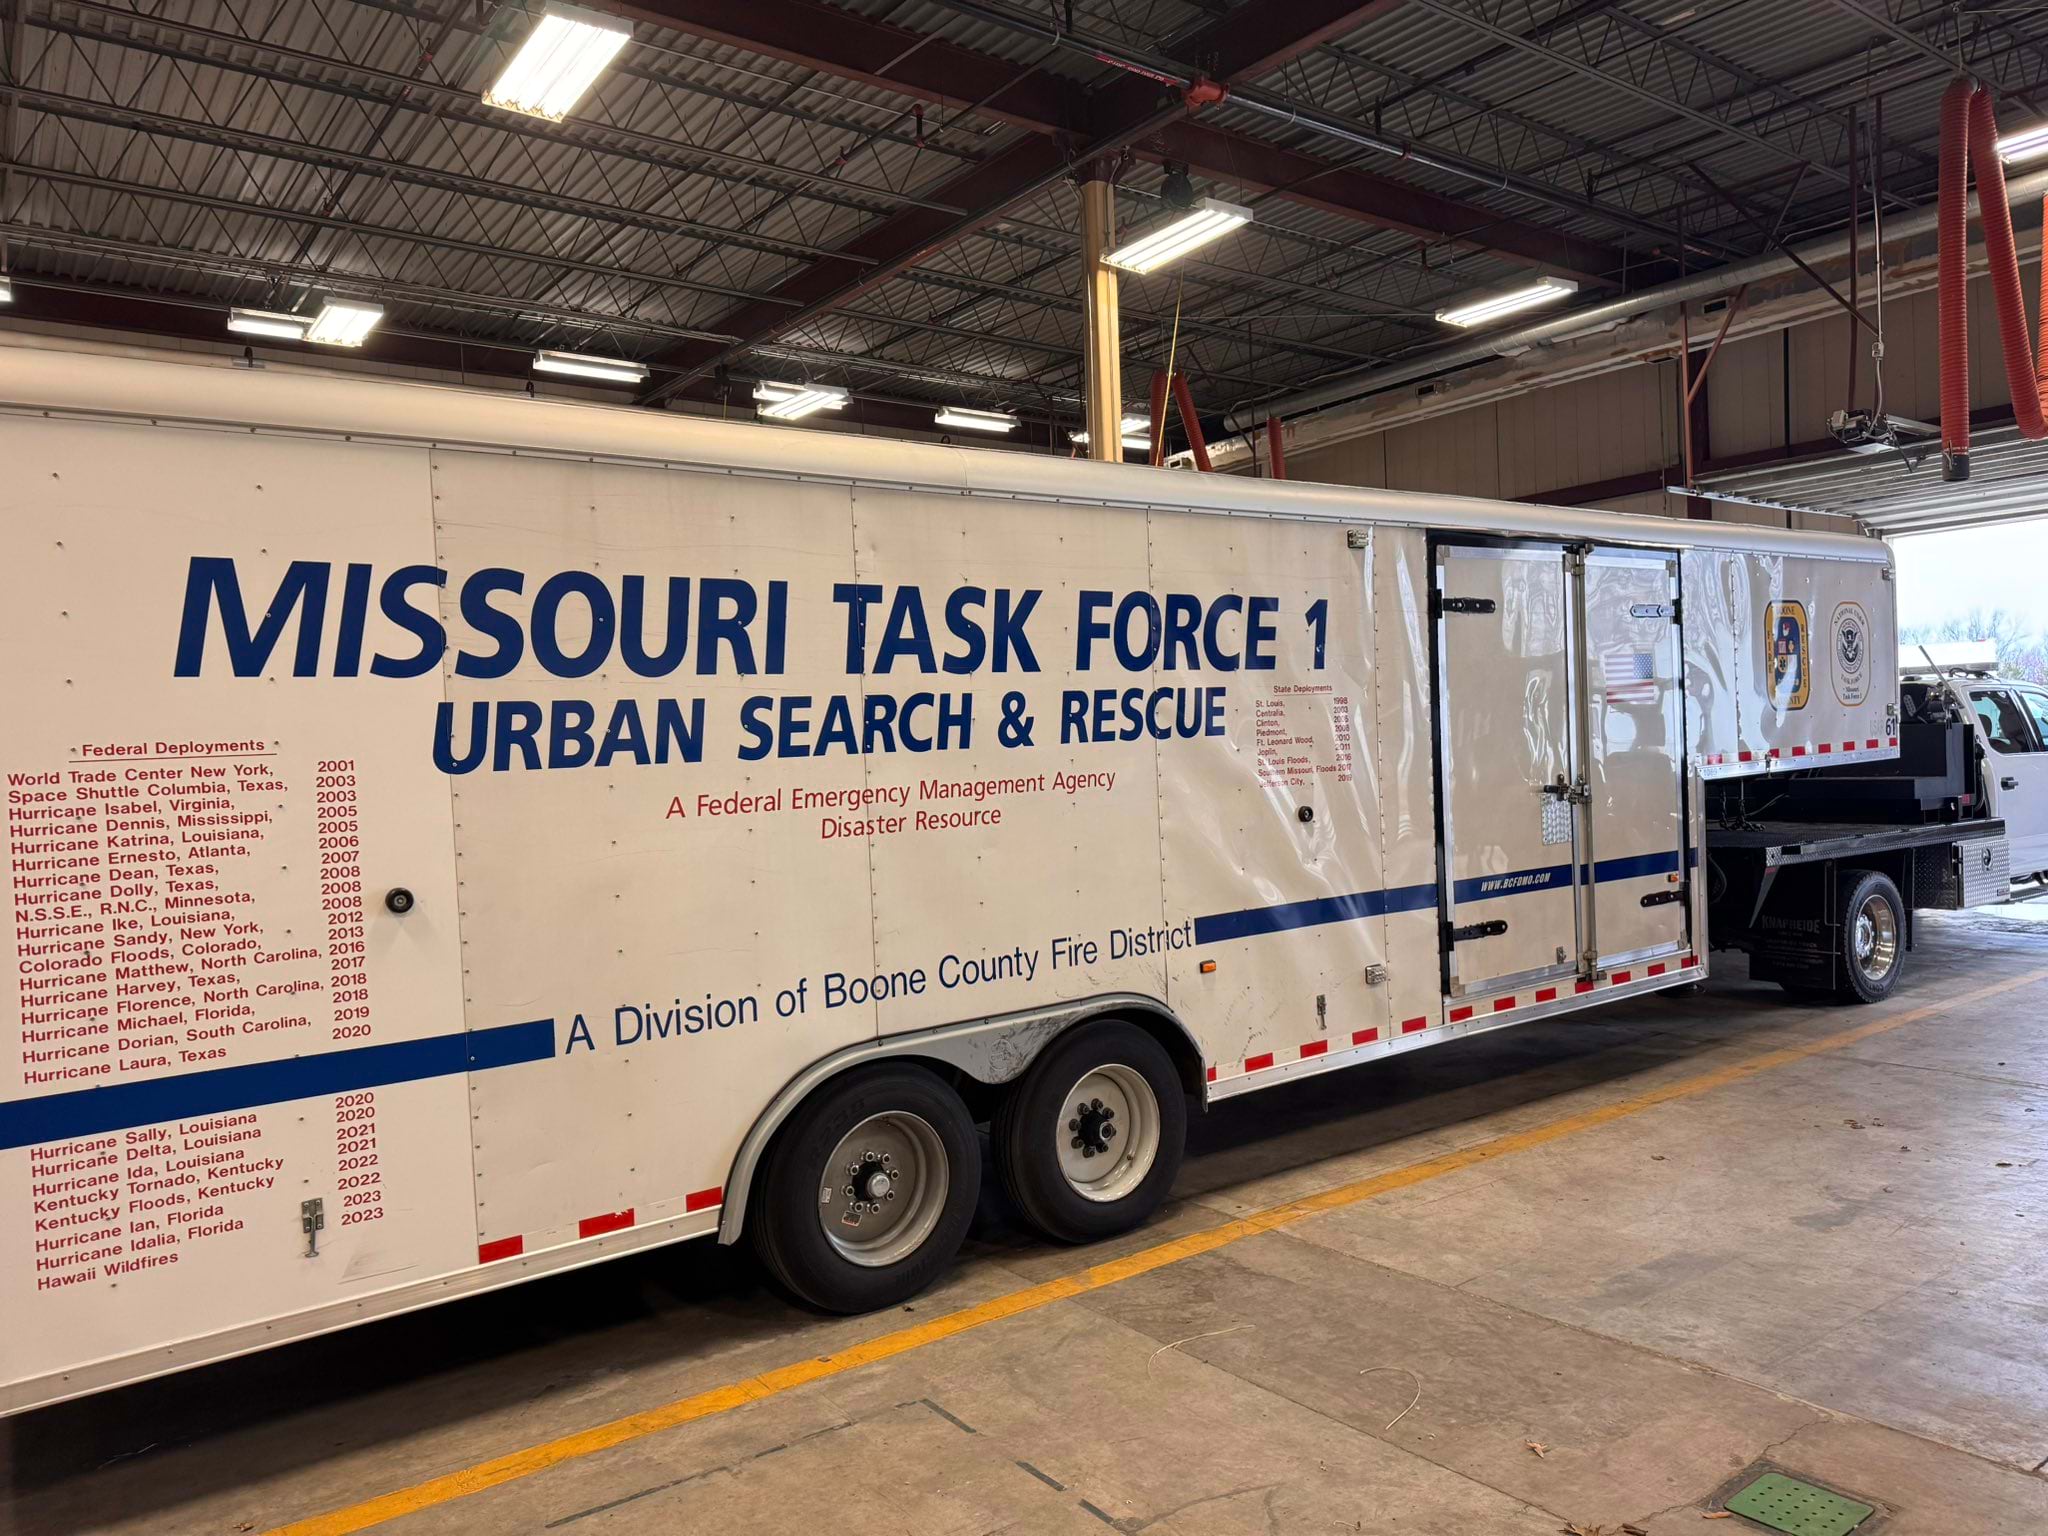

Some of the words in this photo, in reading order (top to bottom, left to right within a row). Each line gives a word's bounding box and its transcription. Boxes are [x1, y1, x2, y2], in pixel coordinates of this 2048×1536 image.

[173, 556, 788, 679] MISSOURI
[833, 583, 1043, 675] TASK
[1075, 590, 1279, 672] FORCE
[1305, 599, 1329, 670] 1
[1266, 699, 1285, 708] Louis,
[1274, 685, 1291, 694] State
[1294, 684, 1332, 693] Deployments
[82, 742, 148, 757] Federal
[155, 739, 265, 755] Deployments
[432, 698, 705, 775] URBAN
[738, 692, 973, 761] SEARCH
[997, 691, 1035, 748] &
[1060, 686, 1226, 744] RESCUE
[1256, 728, 1287, 736] Piedmont,
[1267, 737, 1292, 746] Leonard
[1295, 736, 1314, 744] Wood,
[7, 772, 60, 786] World
[68, 770, 116, 783] Trade
[125, 768, 183, 781] Center
[191, 766, 226, 778] New
[236, 764, 273, 776] York,
[318, 760, 354, 772] 2001
[8, 790, 67, 805] Space
[76, 786, 139, 800] Shuttle
[148, 782, 230, 800] Columbia,
[238, 780, 288, 792] Texas,
[316, 775, 356, 788] 2003
[666, 796, 686, 819] A
[697, 788, 782, 817] Federal
[792, 782, 910, 811] Emergency
[920, 773, 1045, 802] Management
[1053, 769, 1116, 793] Agency
[9, 807, 96, 820] Hurricane
[105, 800, 162, 815] Isabel,
[169, 797, 234, 813] Virginia,
[316, 790, 357, 803] 2003
[10, 823, 97, 838] Hurricane
[106, 818, 169, 832] Dennis,
[178, 812, 272, 828] Mississippi,
[317, 805, 357, 818] 2005
[822, 812, 907, 839] Disaster
[916, 807, 1001, 831] Resource
[11, 840, 98, 854] Hurricane
[107, 834, 174, 848] Katrina,
[182, 830, 264, 843] Louisiana,
[318, 820, 358, 834] 2005
[12, 856, 100, 872] Hurricane
[108, 850, 180, 864] Ernesto,
[188, 846, 250, 859] Atlanta,
[320, 835, 359, 849] 2006
[14, 873, 100, 889] Hurricane
[110, 869, 158, 881] Dean,
[168, 864, 218, 876] Texas,
[322, 850, 360, 864] 2007
[15, 890, 102, 906] Hurricane
[110, 883, 158, 898] Dolly,
[168, 880, 217, 893] Texas,
[320, 866, 360, 880] 2008
[1481, 872, 1551, 892] WWW.BCFDMO.COM
[16, 905, 92, 923] N.S.S.E.,
[100, 899, 157, 915] R.N.C.,
[165, 892, 255, 909] Minnesota,
[322, 880, 362, 895] 2008
[17, 923, 104, 940] Hurricane
[112, 918, 143, 930] Ike,
[151, 911, 234, 926] Louisiana,
[322, 896, 362, 910] 2008
[18, 940, 105, 957] Hurricane
[114, 931, 172, 947] Sandy,
[180, 928, 216, 940] New
[224, 922, 263, 936] York,
[328, 911, 364, 925] 2012
[19, 954, 102, 974] Colorado
[111, 948, 174, 964] Floods,
[182, 940, 261, 956] Colorado,
[329, 926, 364, 940] 2013
[20, 972, 107, 991] Hurricane
[116, 963, 194, 980] Matthew,
[201, 955, 246, 970] North
[254, 948, 322, 964] Carolina,
[329, 941, 365, 956] 2016
[21, 989, 108, 1008] Hurricane
[116, 981, 180, 996] Harvey,
[188, 974, 240, 987] Texas,
[332, 956, 365, 970] 2017
[565, 1014, 595, 1055] A
[615, 991, 759, 1046] Division
[775, 978, 807, 1017] of
[825, 967, 926, 1008] Boone
[938, 946, 1040, 991] County
[1052, 937, 1098, 970] Fire
[1111, 920, 1193, 960] District
[22, 1006, 108, 1025] Hurricane
[117, 996, 195, 1014] Florence,
[204, 987, 248, 1003] North
[256, 981, 324, 996] Carolina,
[331, 973, 367, 988] 2018
[22, 1024, 109, 1043] Hurricane
[118, 1012, 187, 1031] Michael,
[195, 1004, 255, 1021] Florida,
[333, 988, 368, 1003] 2018
[23, 1044, 110, 1064] Hurricane
[118, 1035, 178, 1050] Dorian,
[186, 1025, 235, 1041] South
[242, 1016, 311, 1033] Carolina,
[336, 1006, 369, 1021] 2019
[24, 1064, 111, 1083] Hurricane
[120, 1056, 171, 1071] Laura,
[180, 1048, 226, 1062] Texas
[333, 1024, 371, 1040] 2020
[31, 1138, 117, 1161] Hurricane
[126, 1128, 171, 1144] Sally,
[180, 1114, 257, 1135] Louisiana
[336, 1092, 374, 1109] 2020
[32, 1154, 118, 1178] Hurricane
[127, 1144, 176, 1161] Delta,
[184, 1129, 261, 1150] Louisiana
[336, 1106, 375, 1123] 2020
[33, 1173, 119, 1197] Hurricane
[128, 1166, 158, 1179] Ida,
[166, 1150, 244, 1172] Louisiana
[336, 1123, 375, 1140] 2021
[34, 1189, 118, 1214] Kentucky
[128, 1173, 200, 1194] Tornado,
[208, 1158, 283, 1180] Kentucky
[338, 1138, 376, 1155] 2021
[36, 1207, 120, 1232] Kentucky
[129, 1193, 190, 1213] Floods,
[198, 1177, 274, 1199] Kentucky
[338, 1154, 378, 1171] 2022
[36, 1227, 122, 1252] Hurricane
[130, 1220, 159, 1233] Ian,
[168, 1205, 224, 1225] Florida
[338, 1172, 381, 1190] 2022
[36, 1246, 122, 1271] Hurricane
[131, 1234, 180, 1252] Idalia,
[188, 1219, 244, 1239] Florida
[344, 1190, 381, 1207] 2023
[38, 1270, 96, 1290] Hawaii
[104, 1254, 178, 1276] Wildfires
[342, 1207, 384, 1226] 2023
